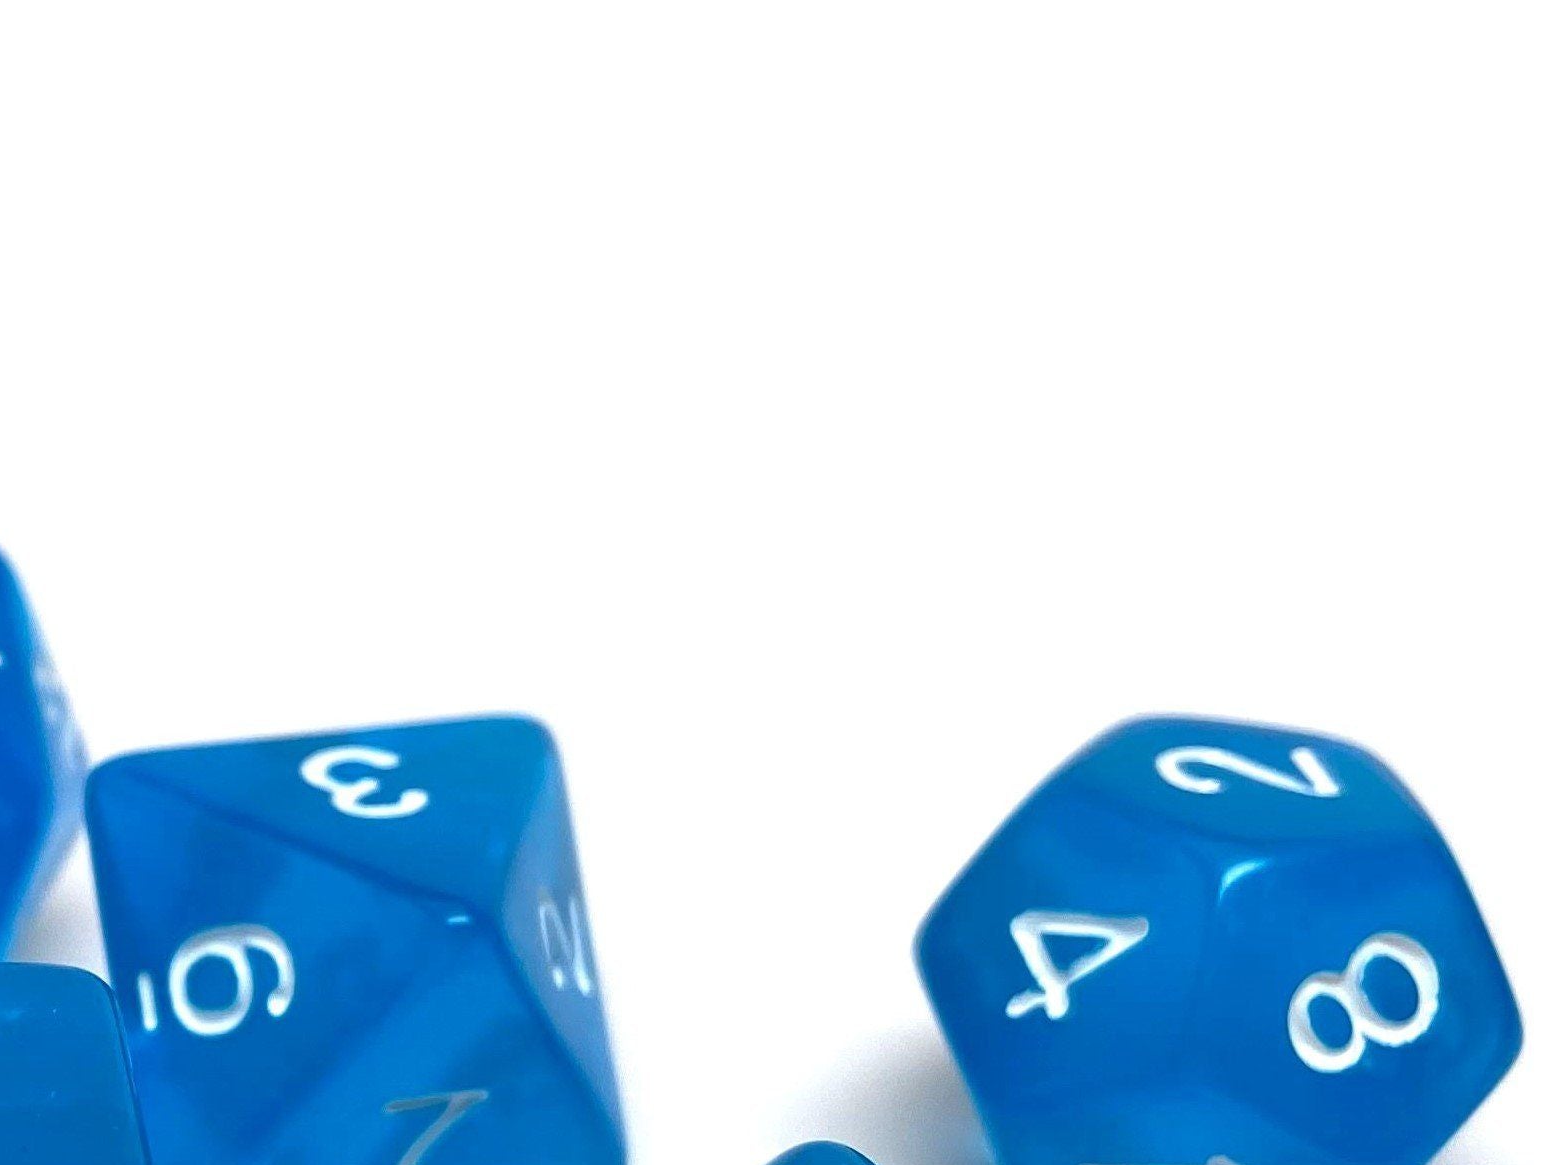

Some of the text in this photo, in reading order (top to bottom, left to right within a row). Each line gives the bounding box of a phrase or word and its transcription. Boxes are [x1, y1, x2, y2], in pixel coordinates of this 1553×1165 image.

[300, 745, 430, 818] 3
[1154, 745, 1342, 798] 2
[1006, 909, 1149, 1019] 4
[1287, 931, 1439, 1073] 8
